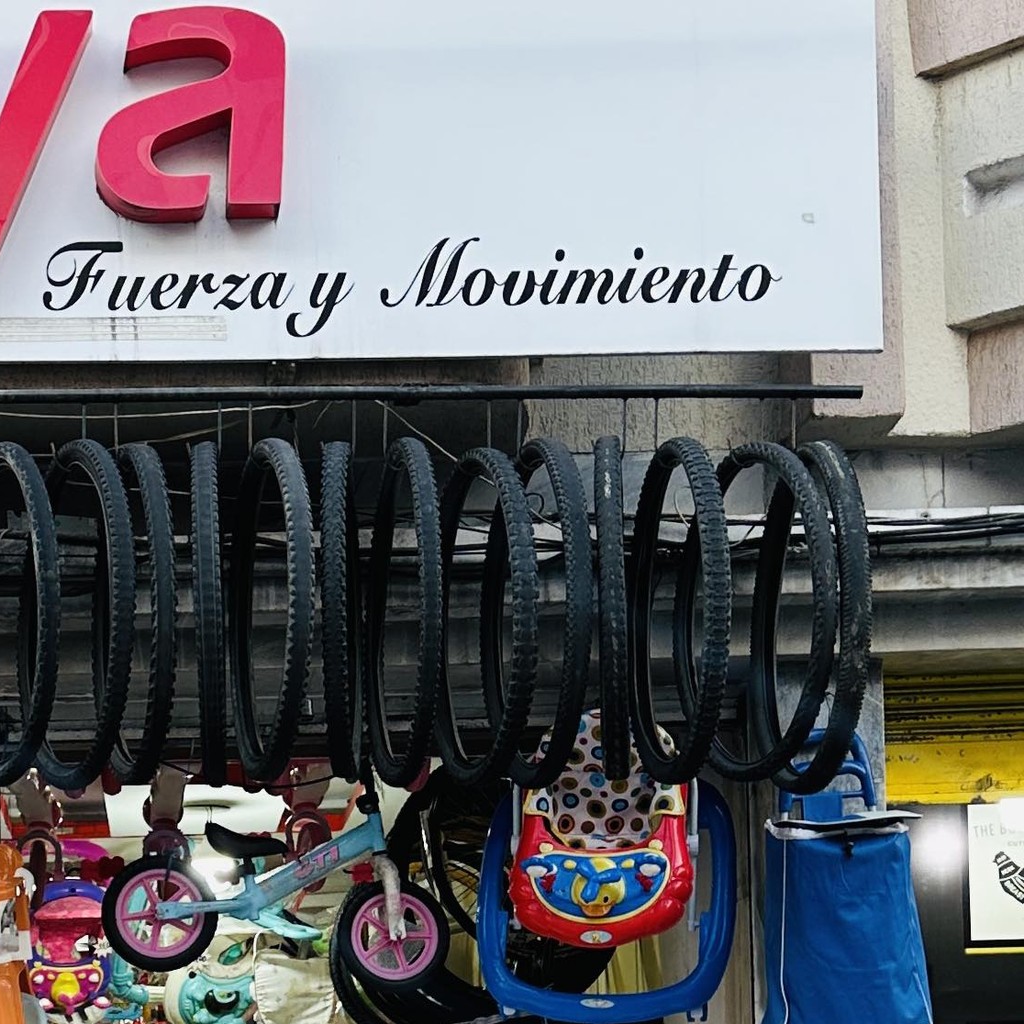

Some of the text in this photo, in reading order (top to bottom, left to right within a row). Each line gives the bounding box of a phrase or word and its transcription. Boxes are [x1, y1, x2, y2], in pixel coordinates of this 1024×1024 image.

[43, 236, 783, 338] Fuerza y Movimiento
